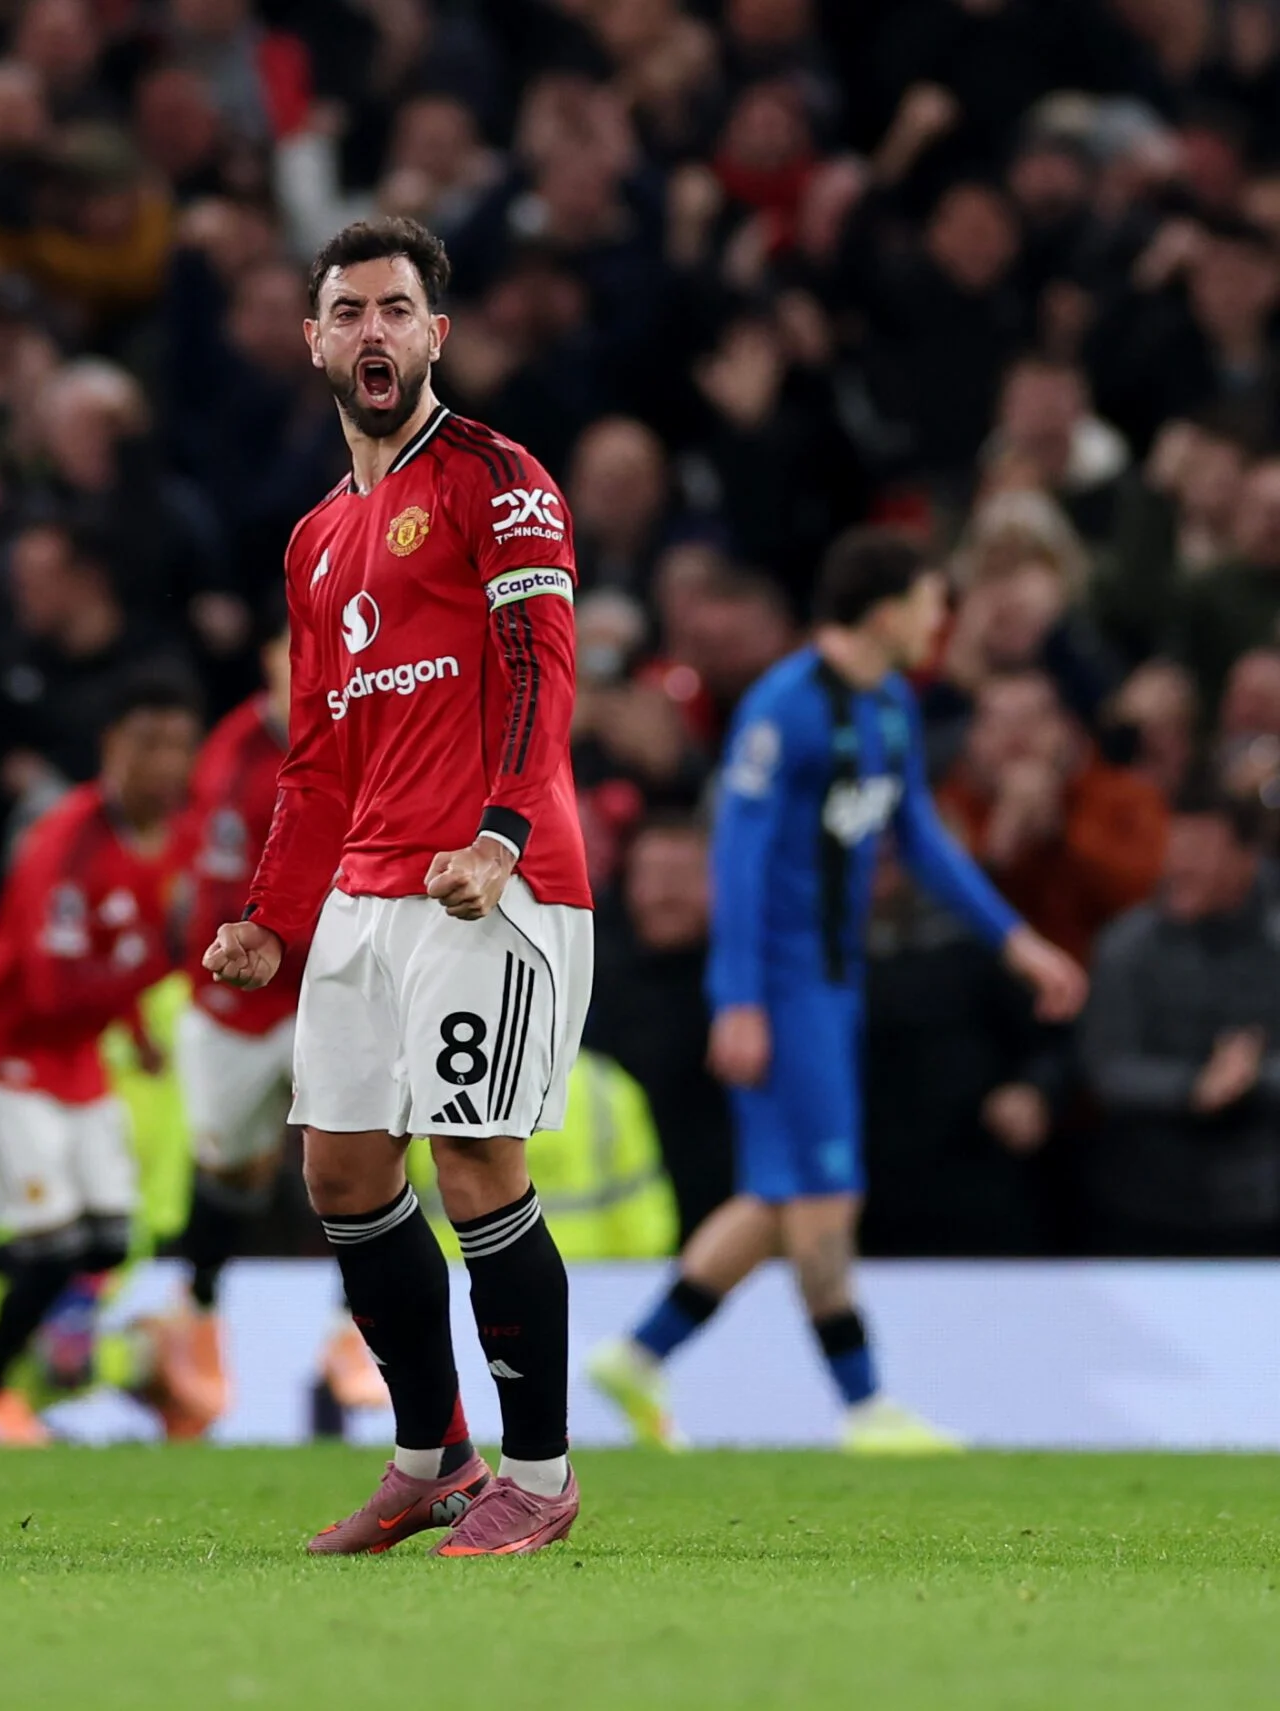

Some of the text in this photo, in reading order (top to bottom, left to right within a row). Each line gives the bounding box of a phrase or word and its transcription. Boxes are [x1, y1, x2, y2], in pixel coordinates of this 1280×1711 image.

[491, 488, 565, 532] DXC
[497, 572, 568, 597] Captain
[436, 1011, 488, 1086] 8
